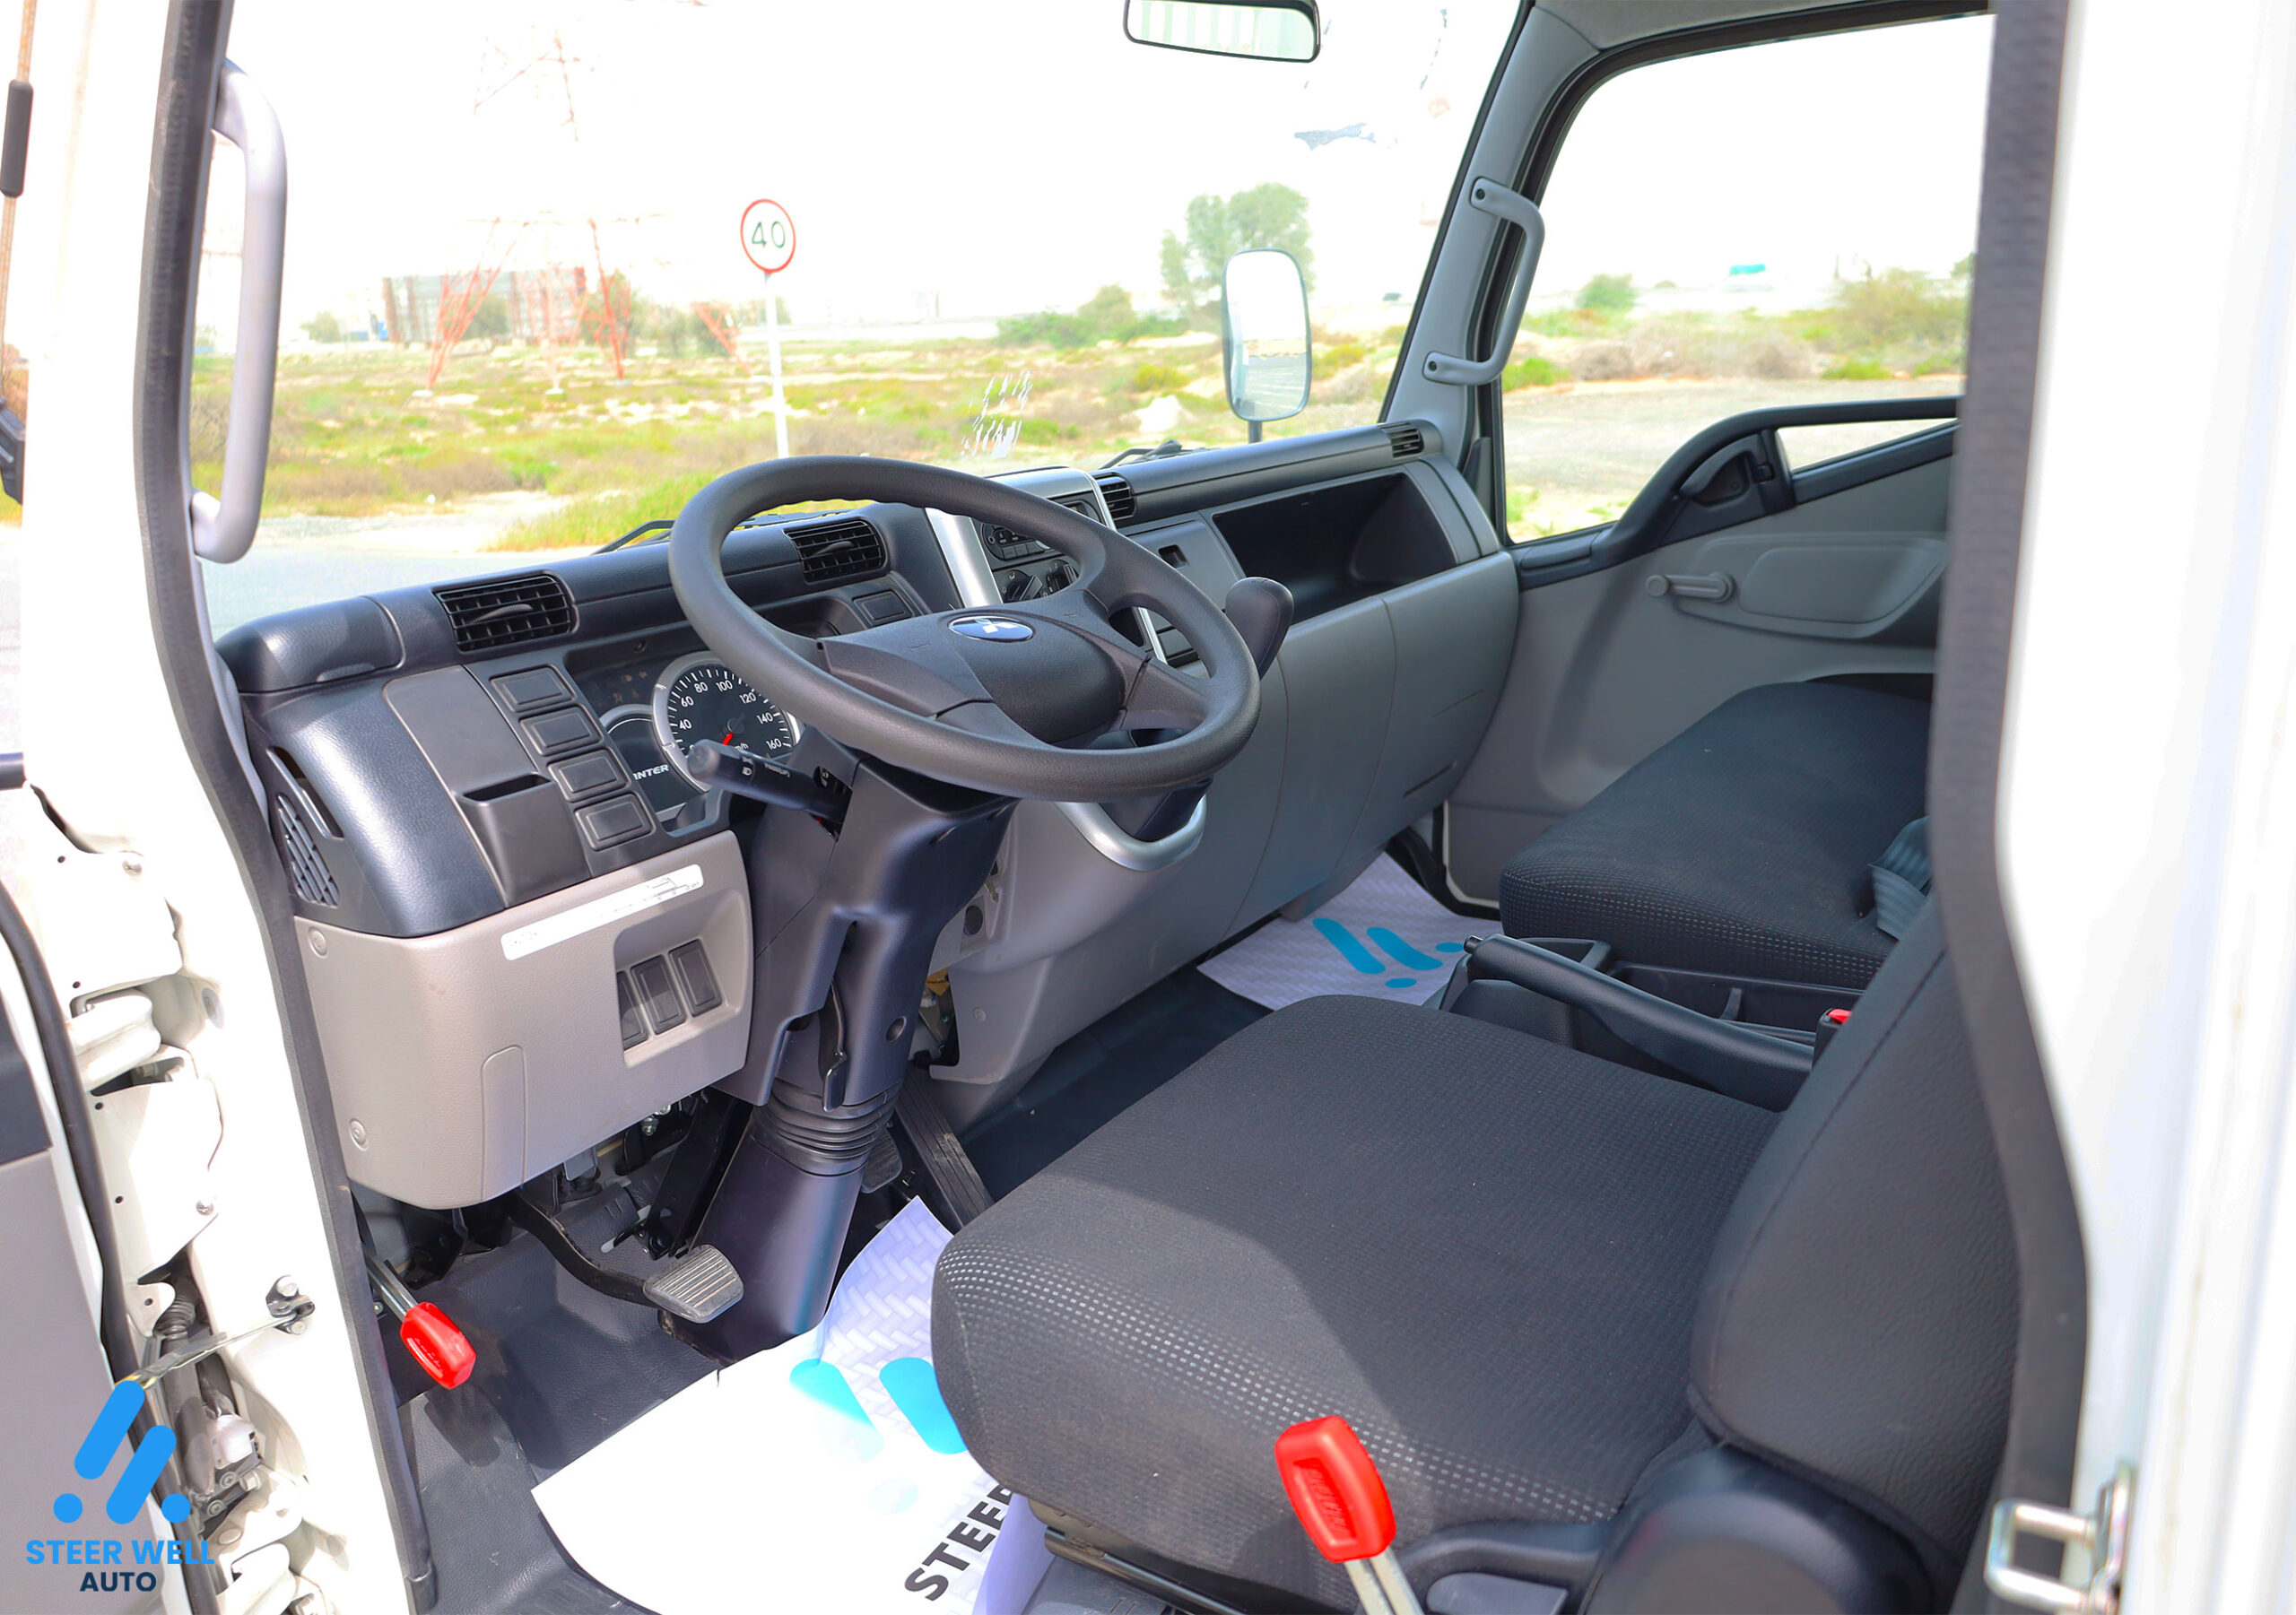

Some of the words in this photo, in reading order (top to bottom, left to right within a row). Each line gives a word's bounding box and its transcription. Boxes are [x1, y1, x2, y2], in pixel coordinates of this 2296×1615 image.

[752, 221, 786, 248] 40
[694, 682, 709, 693] 80
[716, 680, 733, 692] 100
[681, 696, 694, 708] 60
[739, 692, 757, 704] 120
[679, 719, 691, 730] 40
[757, 712, 773, 725] 140
[766, 738, 782, 750] 160
[632, 764, 669, 780] INTER
